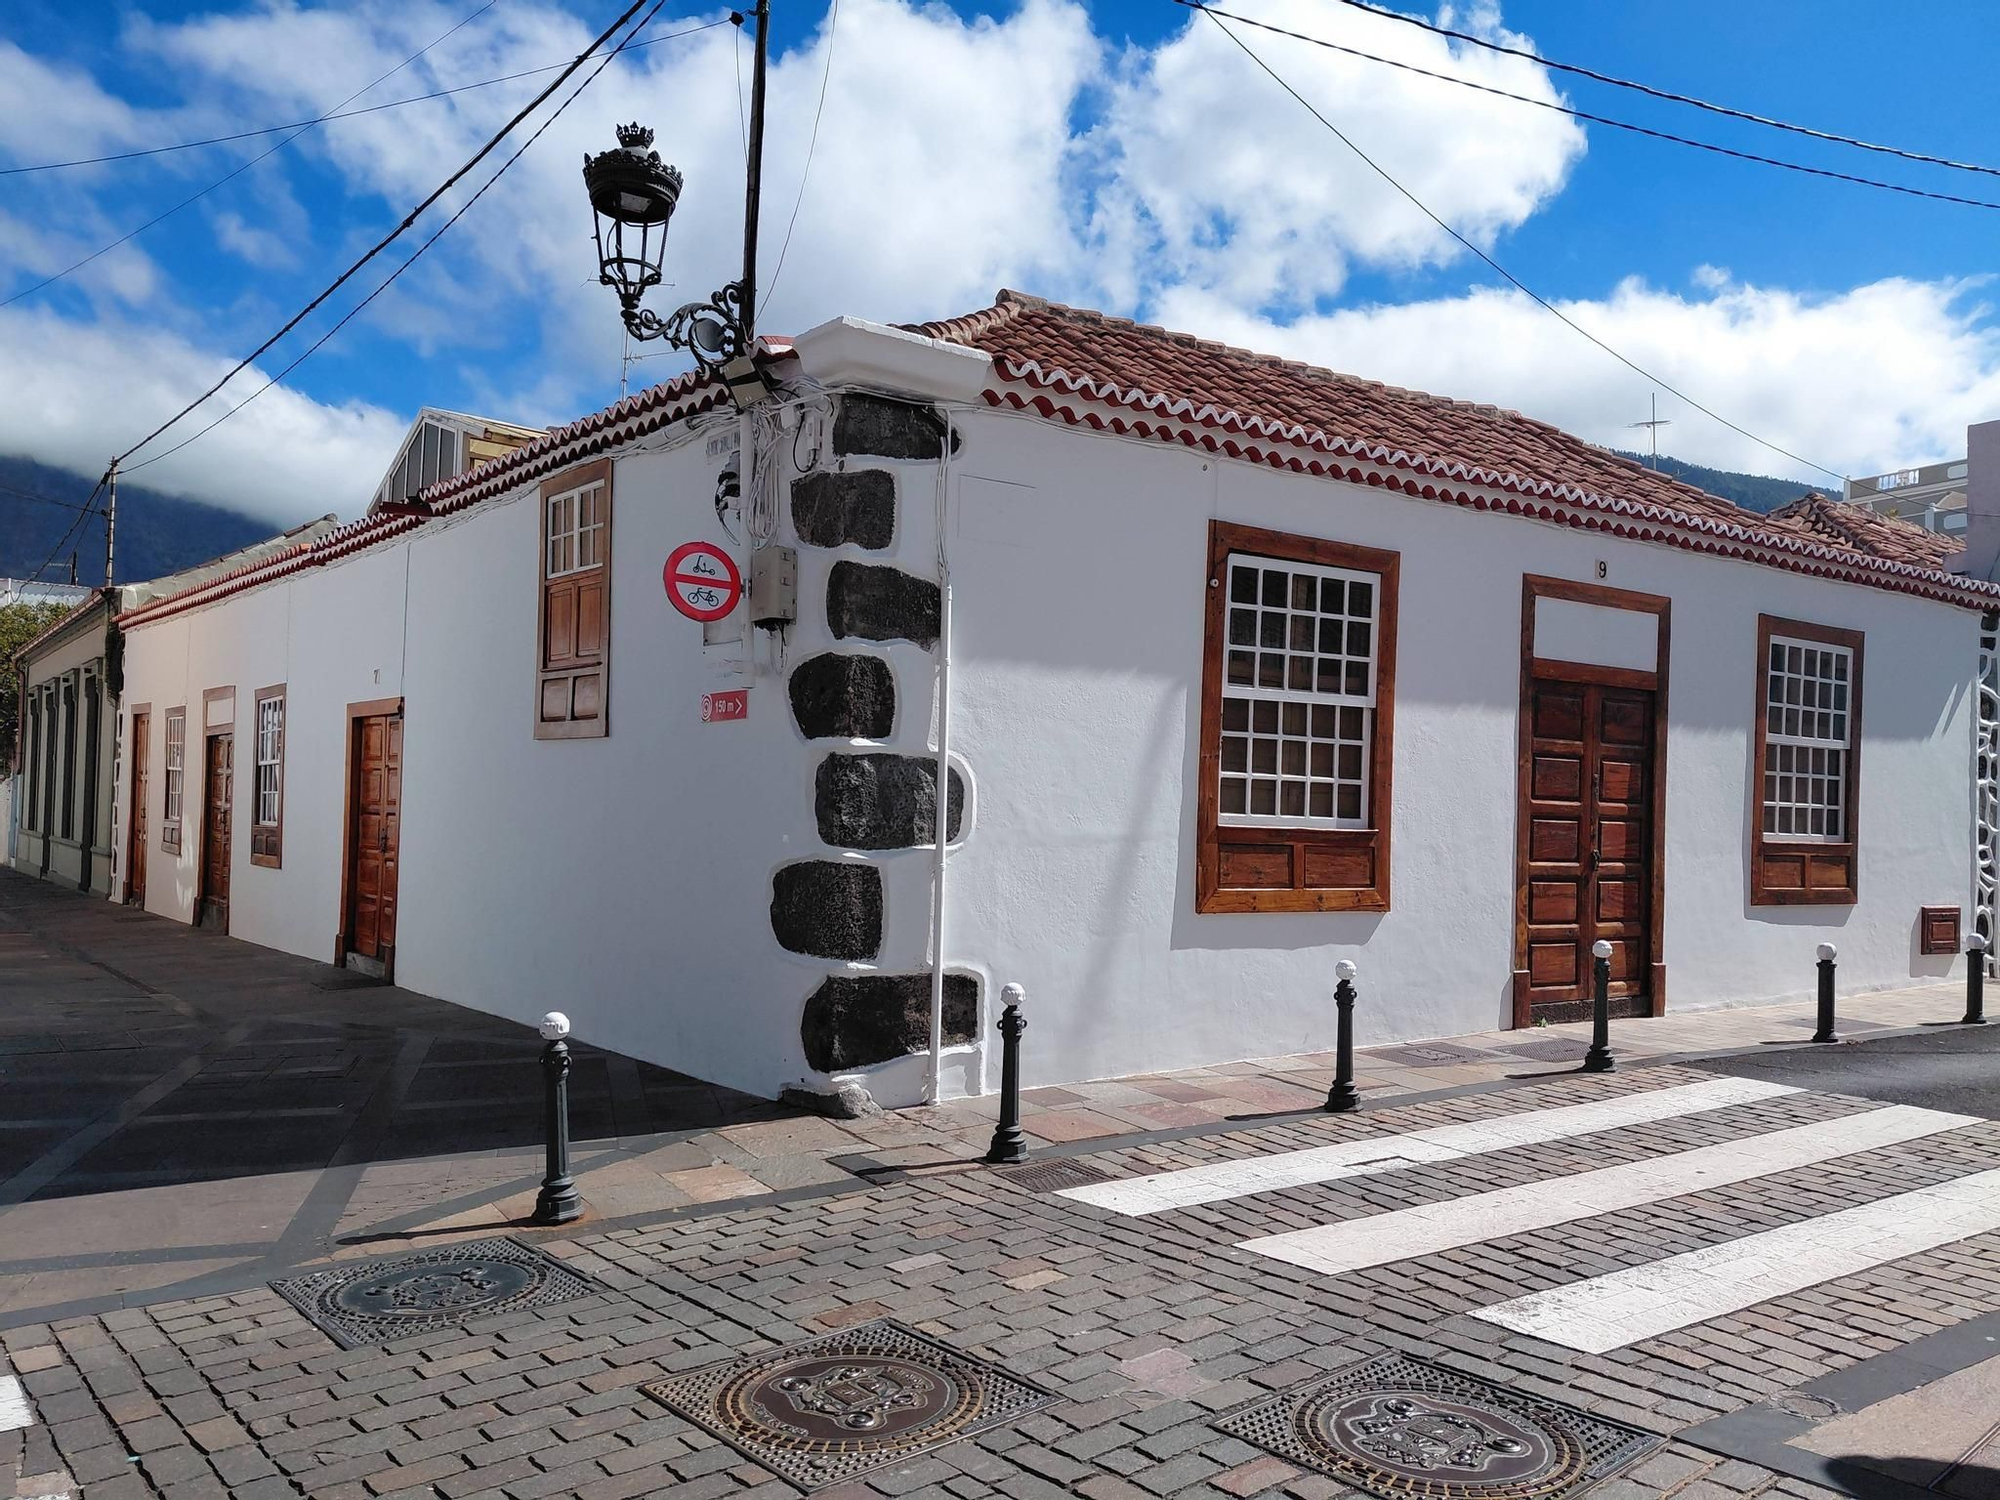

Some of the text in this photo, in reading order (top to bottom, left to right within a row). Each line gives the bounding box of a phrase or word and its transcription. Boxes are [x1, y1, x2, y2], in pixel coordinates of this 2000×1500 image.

[1598, 561, 1607, 578] 9
[715, 699, 734, 713] 150 m
